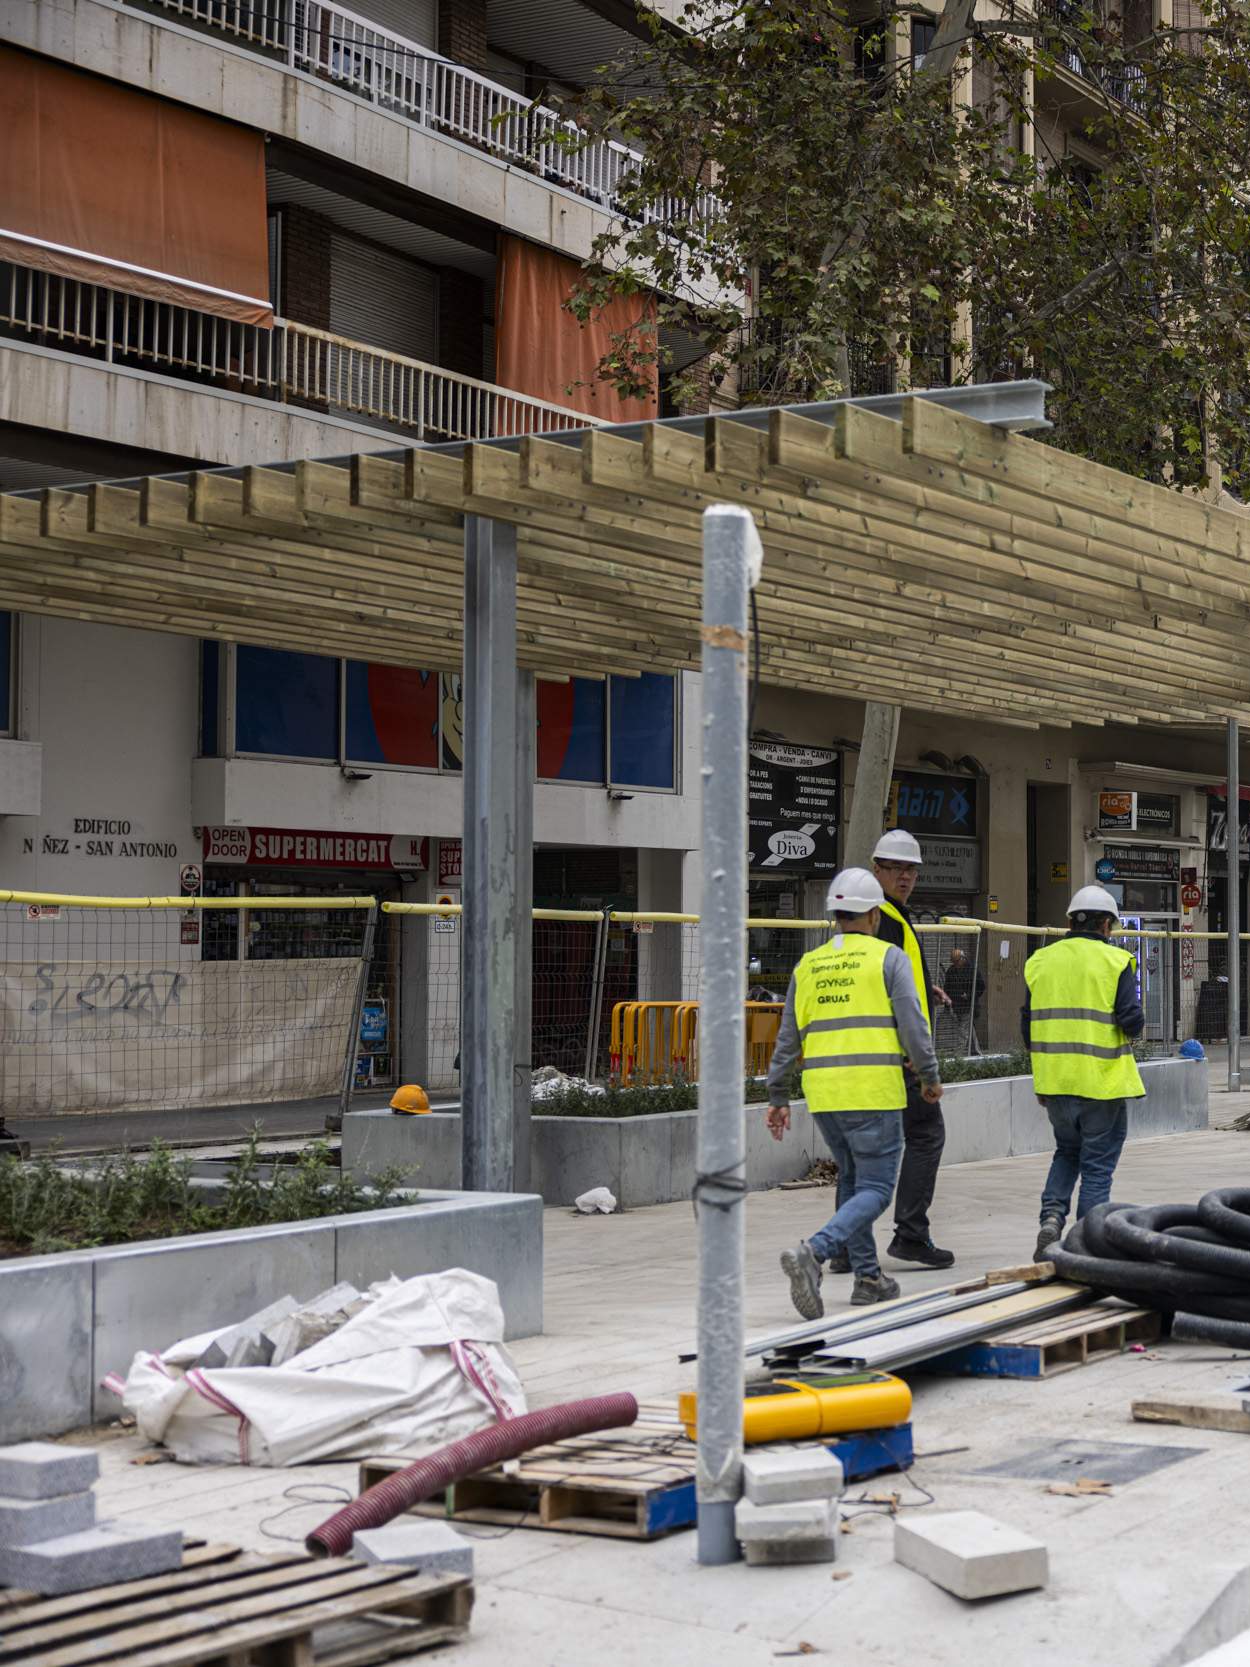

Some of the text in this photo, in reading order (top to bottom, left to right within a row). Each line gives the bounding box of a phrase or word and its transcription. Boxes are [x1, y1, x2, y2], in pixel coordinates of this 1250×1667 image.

[783, 746, 806, 757] VENDA
[811, 750, 832, 760] CANVI
[74, 818, 131, 835] EDIFICIO
[212, 829, 246, 843] OPEN
[86, 840, 114, 857] SAN
[119, 841, 177, 858] ANTONIO
[212, 844, 247, 857] DOOR
[254, 834, 388, 863] SUPERMERCAT
[776, 840, 808, 855] Diva
[440, 850, 463, 862] SUP
[1183, 888, 1199, 899] ria
[817, 994, 851, 1004] GRUAS
